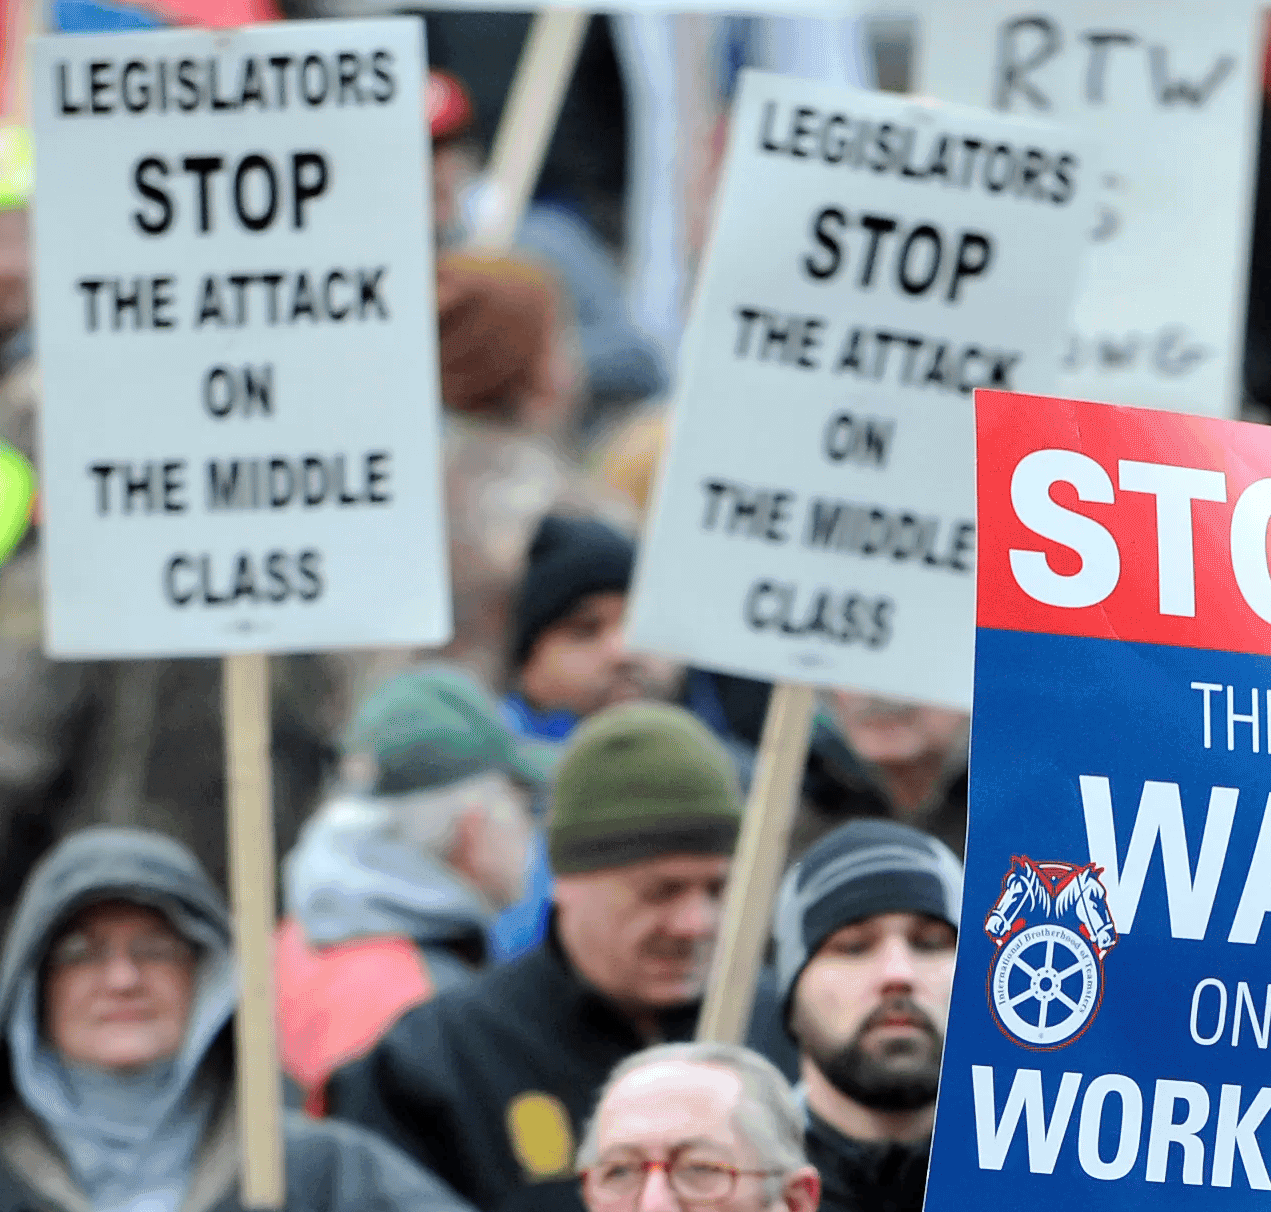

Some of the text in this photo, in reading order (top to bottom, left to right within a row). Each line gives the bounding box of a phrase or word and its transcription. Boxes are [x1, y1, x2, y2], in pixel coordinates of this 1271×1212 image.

[57, 50, 397, 117] LEGISLATORS
[995, 15, 1236, 113] RTW
[758, 100, 1080, 204] LEGISLATORS
[133, 150, 331, 236] STOP
[803, 206, 994, 303] STOP
[78, 267, 390, 332] THE ATTACK
[732, 307, 826, 370] THE
[838, 331, 1023, 395] ATTACK
[202, 363, 275, 419] ON
[823, 412, 893, 470] ON
[89, 453, 393, 516] THE MIDDLE
[701, 481, 975, 573] THE MIDDLE
[163, 550, 327, 607] CLASS
[744, 580, 894, 649] CLASS
